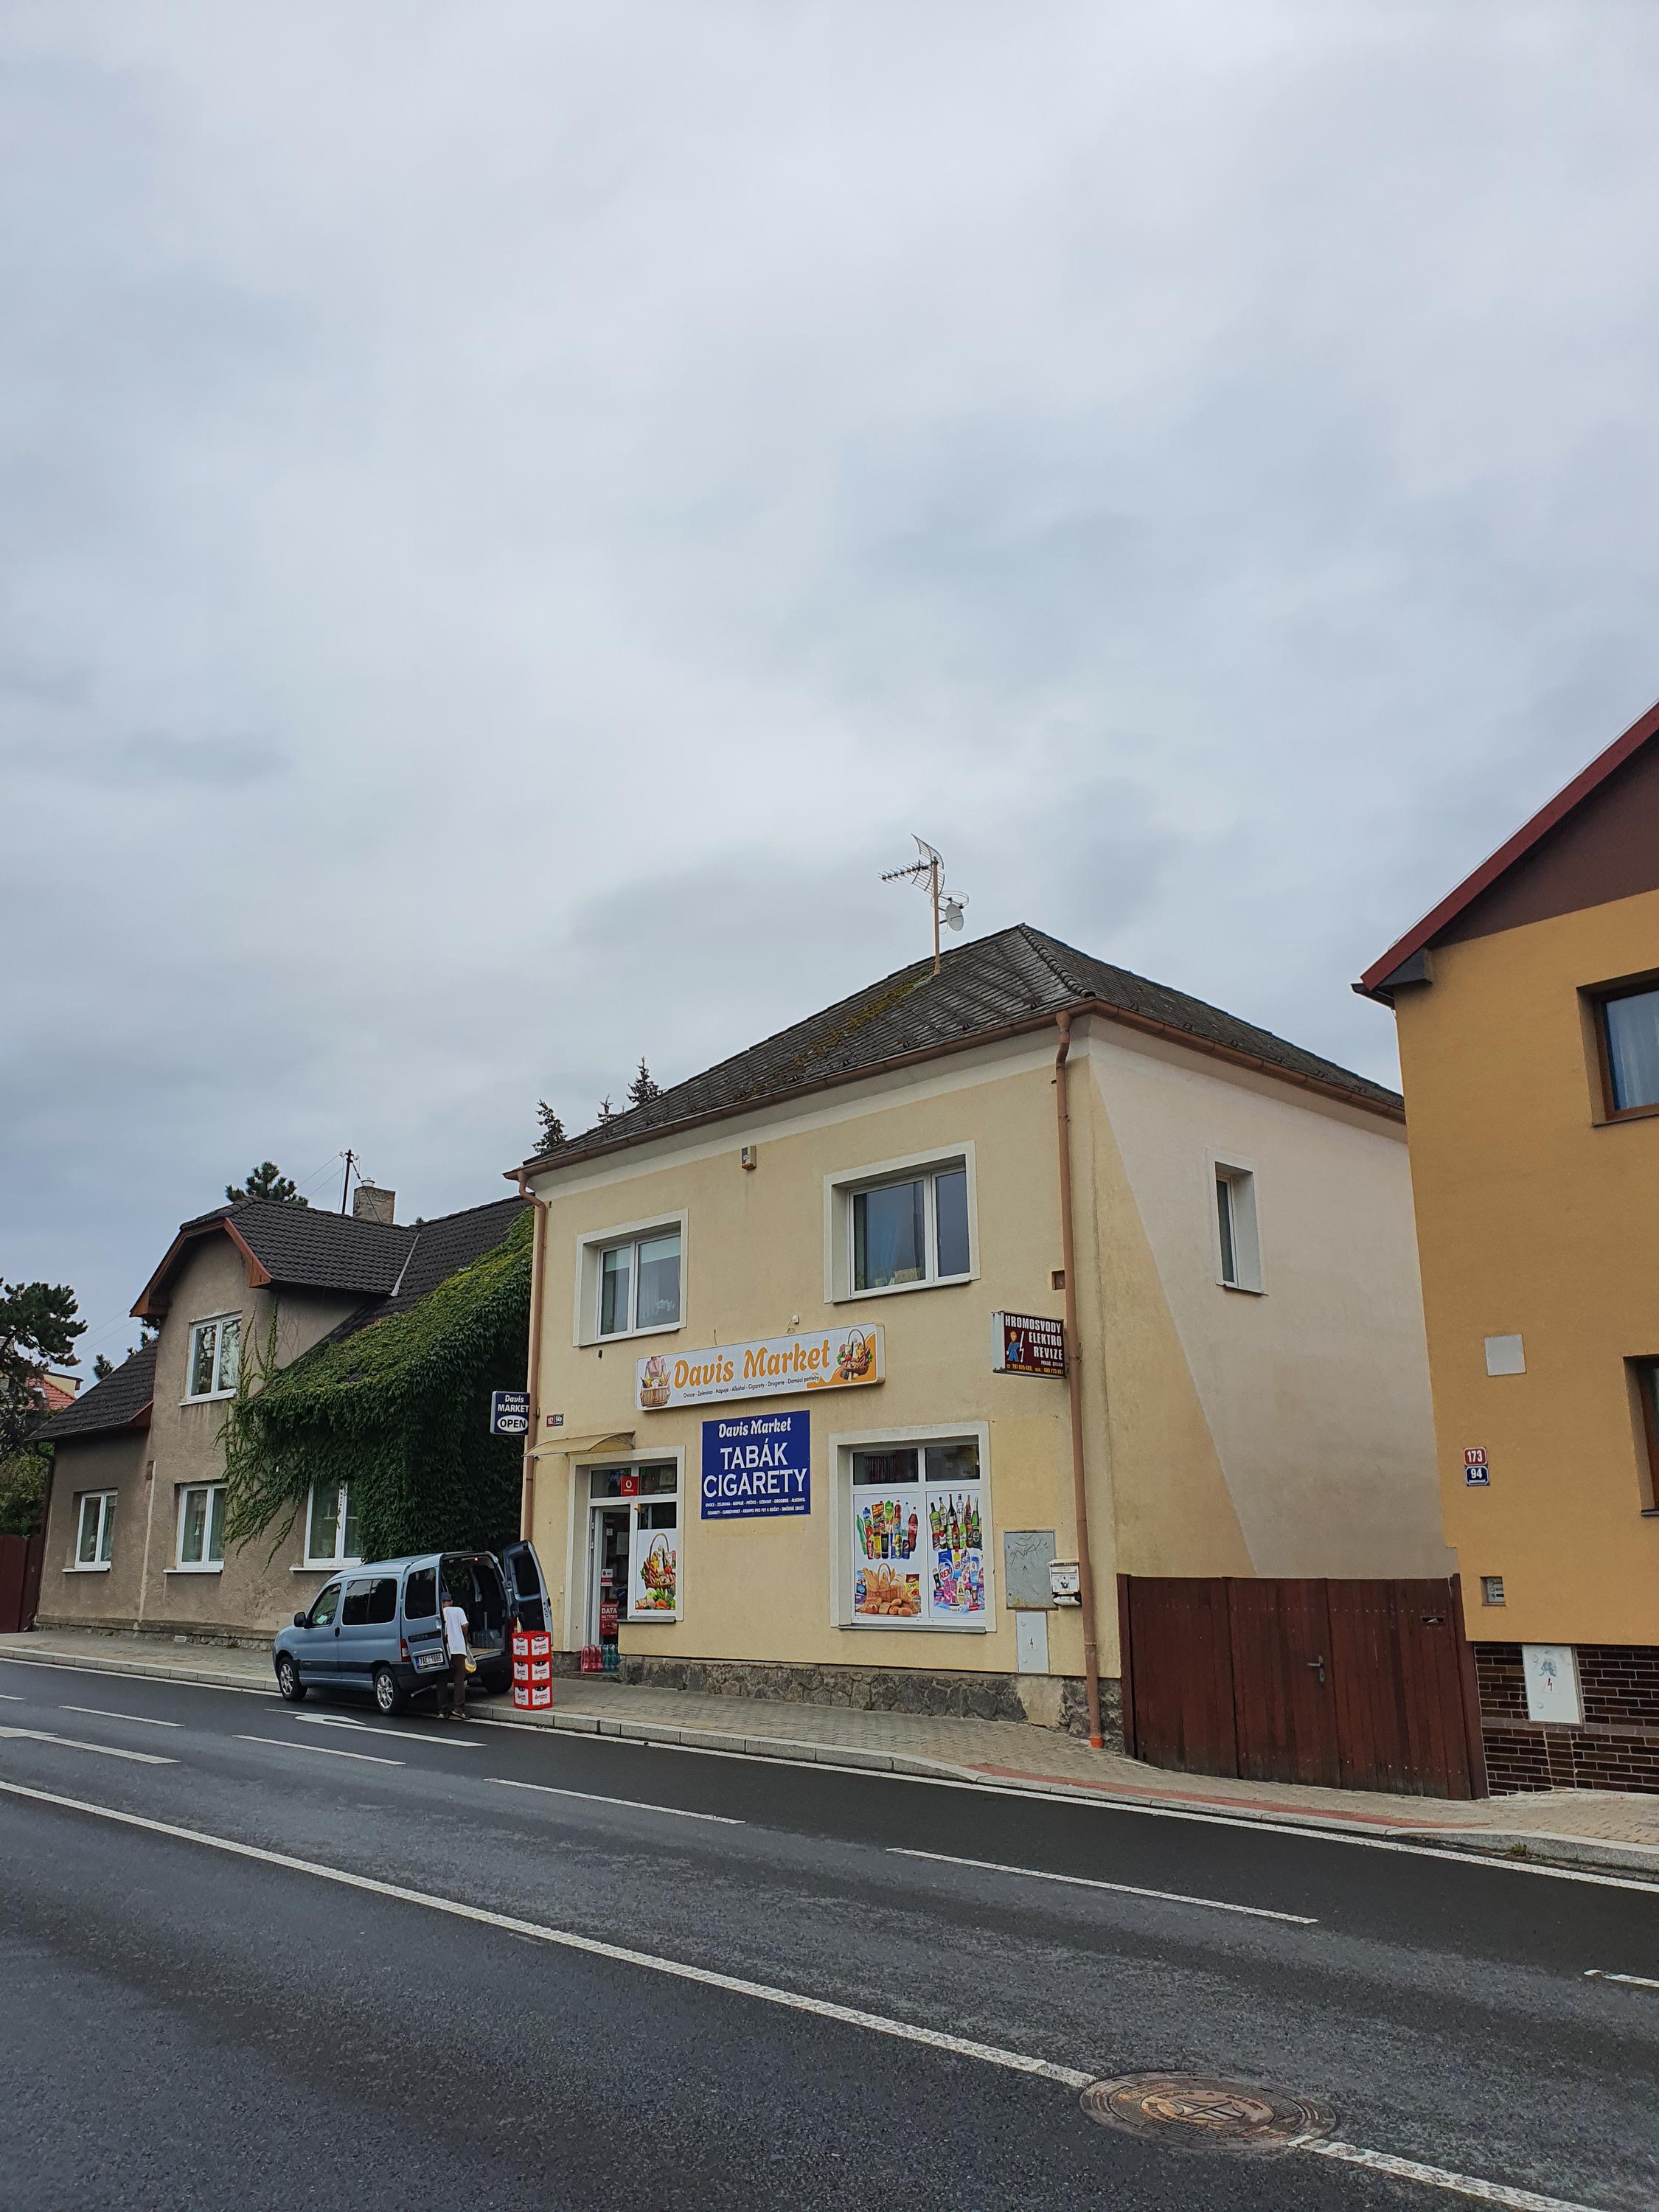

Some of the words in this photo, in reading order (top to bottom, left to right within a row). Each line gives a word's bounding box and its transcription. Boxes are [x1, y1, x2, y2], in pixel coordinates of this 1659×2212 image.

[1005, 1315, 1061, 1334] HROMOSVODY
[1029, 1332, 1062, 1346] ELEKTRO
[1033, 1346, 1062, 1360] REVIZE
[674, 1354, 734, 1388] Davis
[743, 1339, 830, 1380] Market
[504, 1394, 524, 1403] Davis
[497, 1404, 529, 1413] MARKET
[500, 1419, 526, 1428] OPEN
[718, 1422, 748, 1439] Davis
[751, 1417, 792, 1435] Market
[720, 1438, 789, 1470] TABÁK
[1467, 1450, 1483, 1463] 173
[1470, 1468, 1483, 1479] 94
[703, 1468, 808, 1498] CIGARETY
